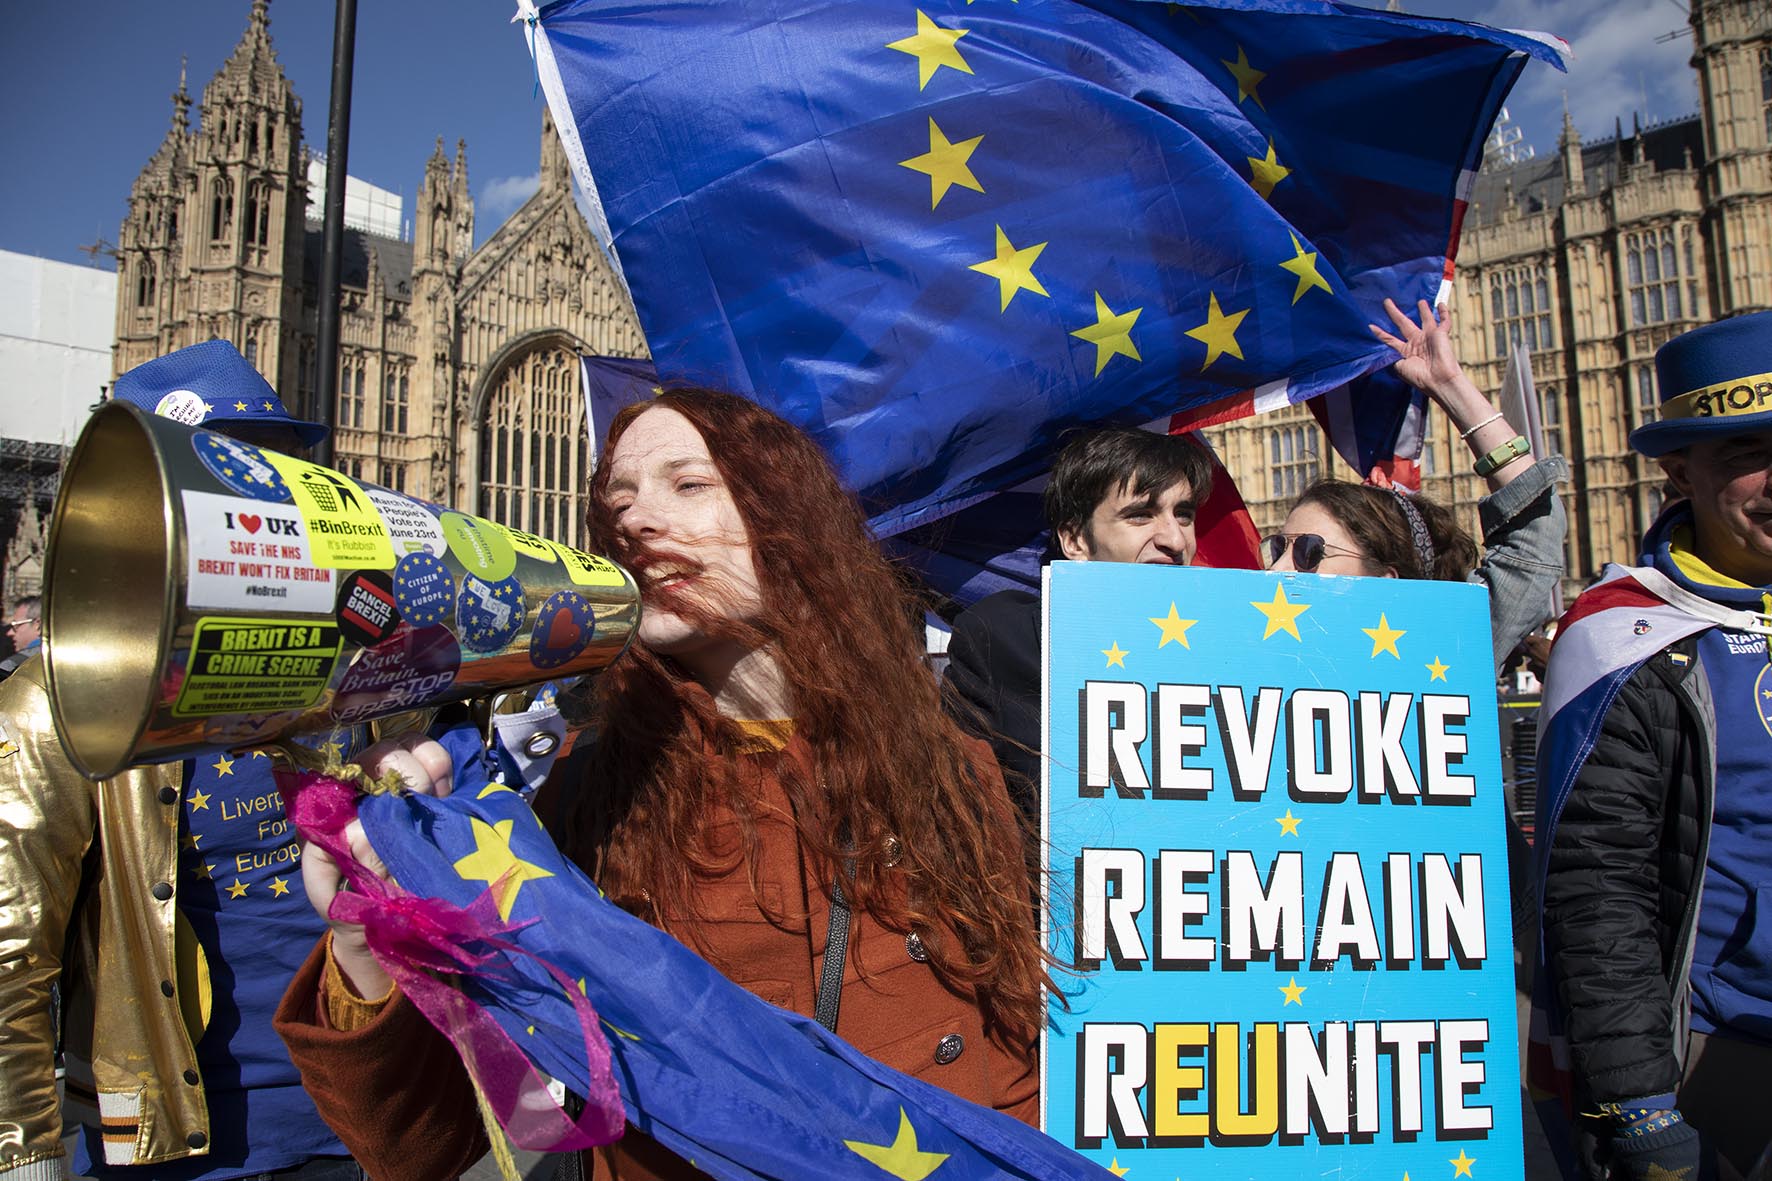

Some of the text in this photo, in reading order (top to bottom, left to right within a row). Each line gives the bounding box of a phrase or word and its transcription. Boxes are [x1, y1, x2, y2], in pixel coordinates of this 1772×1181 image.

[1696, 382, 1772, 417] STOP
[370, 496, 416, 508] March for
[384, 507, 427, 519] People's
[224, 512, 300, 536] I UK
[310, 519, 384, 537] #BinBrexit
[387, 517, 428, 528] Vote on
[390, 527, 437, 539] June 23rd
[229, 540, 257, 556] SAVE
[282, 545, 301, 560] NHS
[327, 540, 376, 551] It's Rubbish
[198, 559, 330, 583] BREXIT WON'T FIX BRITAIN
[408, 573, 438, 588] CITIZEN
[246, 585, 287, 598] #NoBrexit
[412, 592, 443, 607] EUROPE
[420, 585, 431, 594] OF
[346, 595, 389, 628] BREXIT
[352, 586, 392, 619] CANCEL
[220, 627, 322, 651] BREXIT IS A
[206, 654, 322, 676] CRIME SCENE
[358, 652, 405, 672] Save
[341, 664, 418, 693] Britain.
[387, 671, 454, 698] STOP
[1078, 679, 1476, 807] REVOKE
[258, 818, 288, 840] For
[236, 843, 300, 873] Europ
[1074, 847, 1488, 972] REMAIN
[1075, 1018, 1494, 1150] REUNITE
